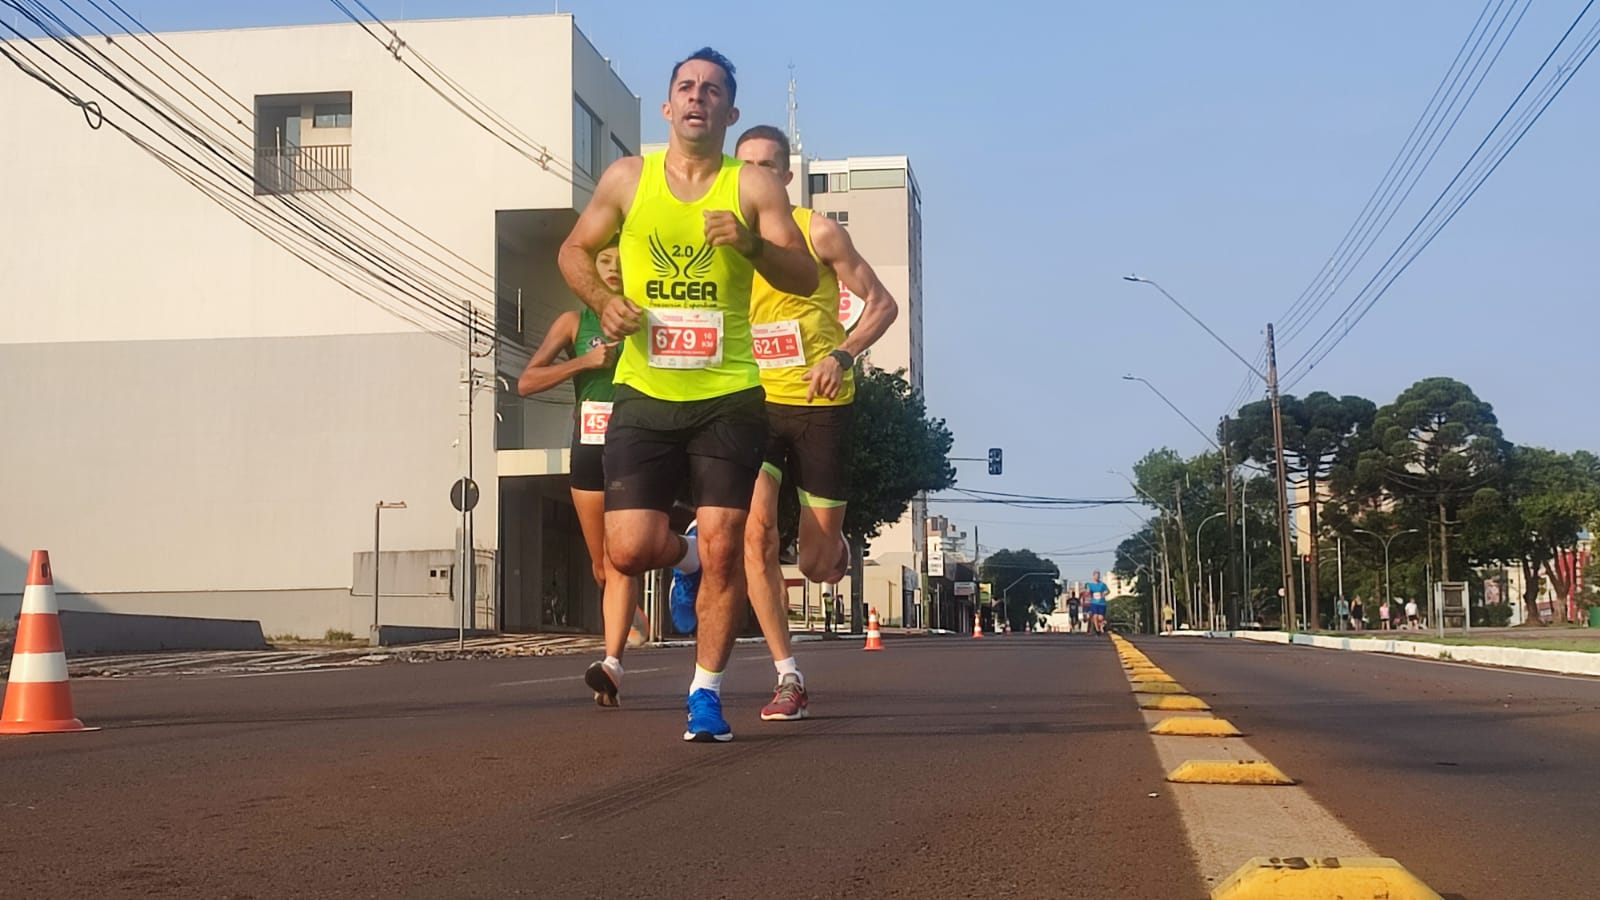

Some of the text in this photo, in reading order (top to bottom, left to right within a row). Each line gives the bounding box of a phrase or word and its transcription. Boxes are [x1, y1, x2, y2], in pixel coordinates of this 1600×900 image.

[672, 244, 693, 258] 2.0
[646, 280, 717, 300] ELGER
[656, 328, 697, 350] 679
[753, 338, 780, 354] 621
